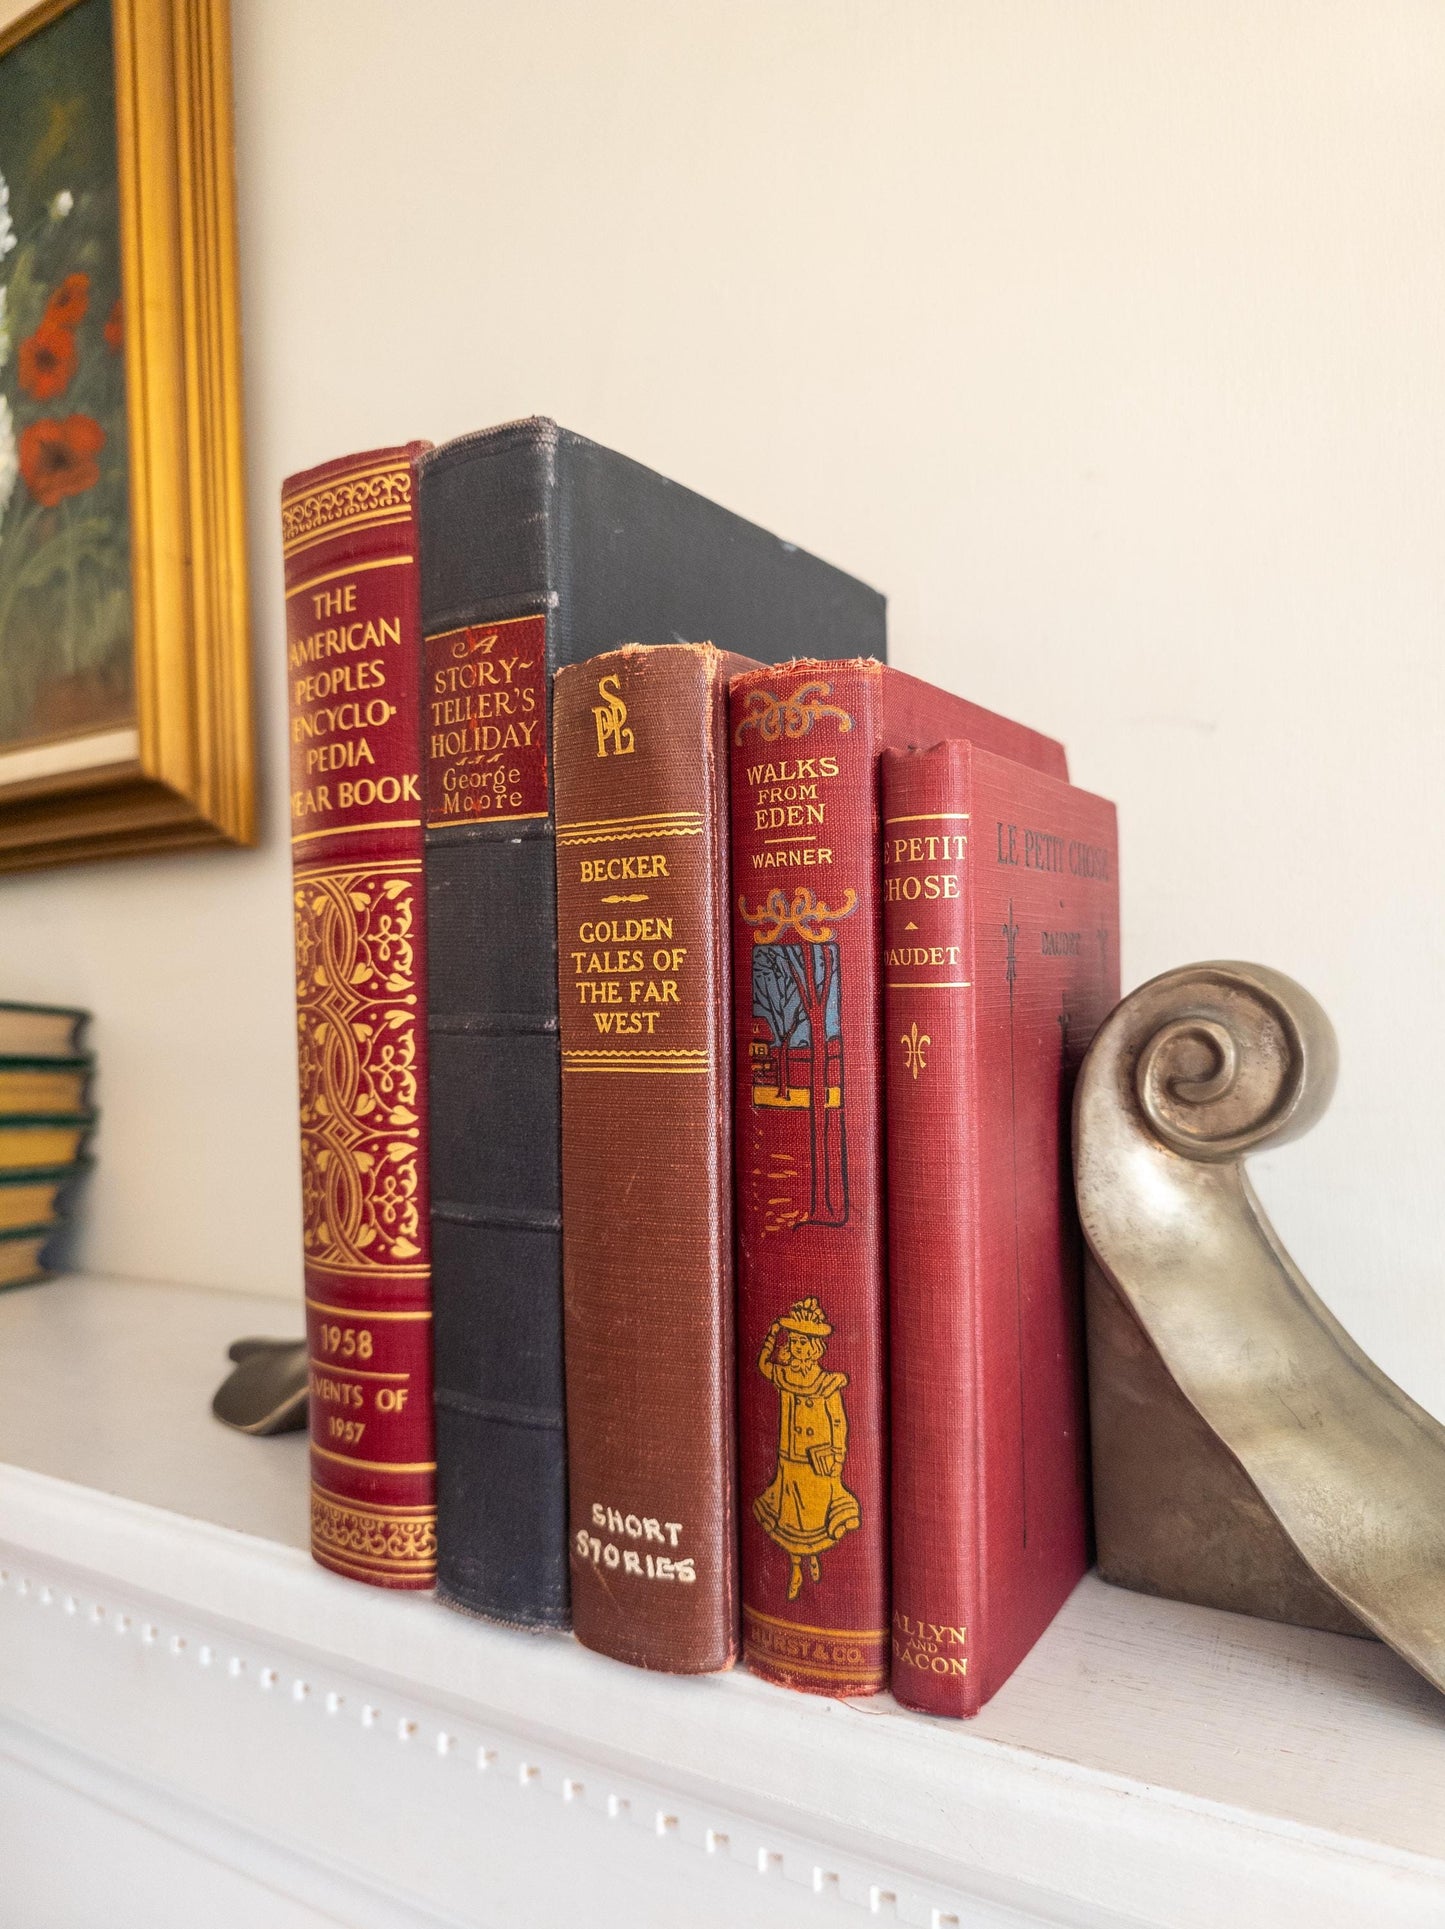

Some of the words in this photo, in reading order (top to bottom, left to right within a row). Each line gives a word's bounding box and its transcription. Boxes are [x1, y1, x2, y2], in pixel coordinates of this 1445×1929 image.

[313, 584, 358, 620] THE
[288, 617, 401, 670] AMERICAN
[295, 659, 386, 705] PEOPLES
[292, 699, 397, 744] ENCYCLO-
[431, 688, 535, 726] TELLER'S
[430, 720, 539, 759] HOLIDAY
[306, 737, 375, 774] PEDIA
[443, 765, 521, 794] George
[746, 756, 839, 786] WALKS
[339, 774, 421, 808] BOOK
[443, 790, 523, 815] Moore
[757, 784, 819, 805] FROM
[754, 803, 826, 831] EDEN
[752, 848, 833, 869] WARNER
[894, 836, 968, 863] PETIT
[997, 822, 1018, 866] LE
[1024, 828, 1064, 874] PETIT
[580, 855, 670, 883] BECKER
[579, 918, 673, 943] GOLDEN
[571, 950, 645, 973] TALES
[652, 948, 687, 972] OF
[575, 981, 622, 1004] THE
[629, 979, 681, 1003] FAR
[593, 1011, 660, 1034] WEST
[321, 1322, 374, 1359] 1958
[375, 1388, 409, 1412] OF
[329, 1415, 366, 1443] 1957
[591, 1502, 684, 1547] SHORT
[576, 1529, 697, 1583] STORIES
[893, 1609, 967, 1645] ALLYN
[907, 1637, 938, 1653] AND
